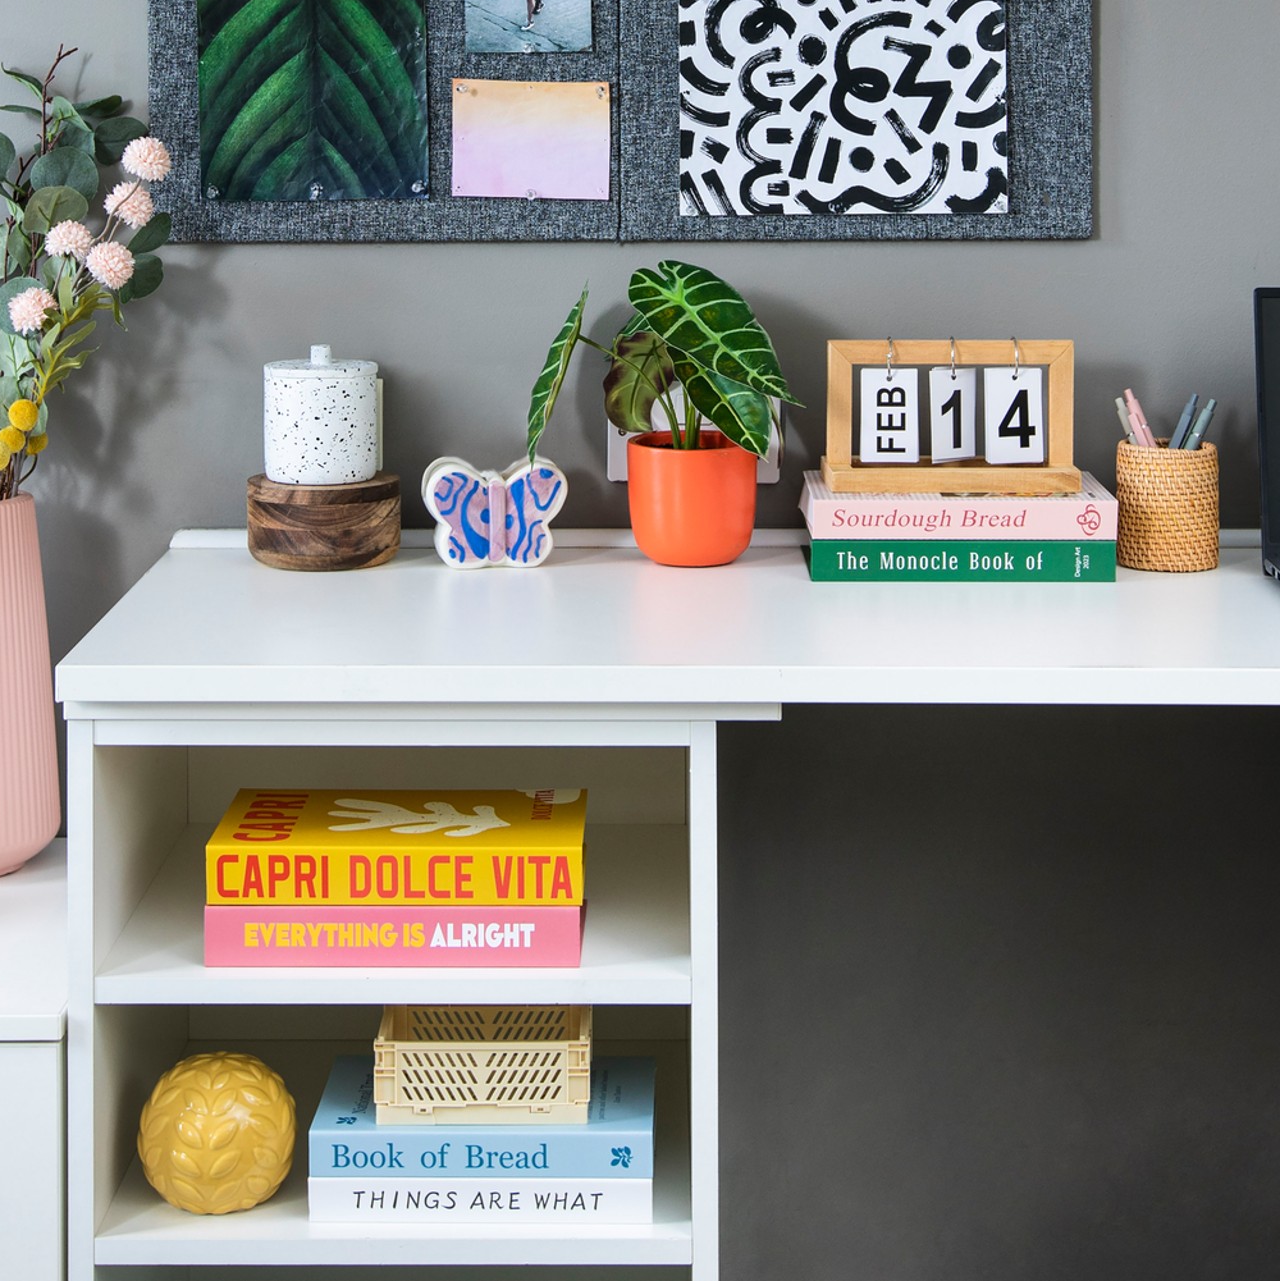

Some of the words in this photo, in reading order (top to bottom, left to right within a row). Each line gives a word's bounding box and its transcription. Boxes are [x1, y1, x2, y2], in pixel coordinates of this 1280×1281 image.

[876, 386, 906, 453] FEB
[831, 508, 952, 532] Sourdough
[961, 509, 1027, 528] Bread
[836, 550, 869, 571] The
[879, 550, 959, 571] Monocle
[969, 551, 1015, 571] Book
[1025, 550, 1044, 571] of
[1074, 556, 1082, 578] Design
[232, 793, 310, 842] CAPRI
[216, 854, 329, 899] CAPRI
[349, 854, 474, 899] DOLCE
[492, 855, 573, 899] VITA
[244, 923, 398, 948] EVERYTHING
[403, 923, 425, 948] IS
[429, 922, 536, 948] ALRIGHT
[331, 1142, 405, 1169] Book
[420, 1142, 451, 1169] of
[464, 1142, 550, 1169] Bread
[352, 1190, 458, 1210] THINGS
[469, 1190, 521, 1211] ARE
[533, 1191, 604, 1211] WHAT
